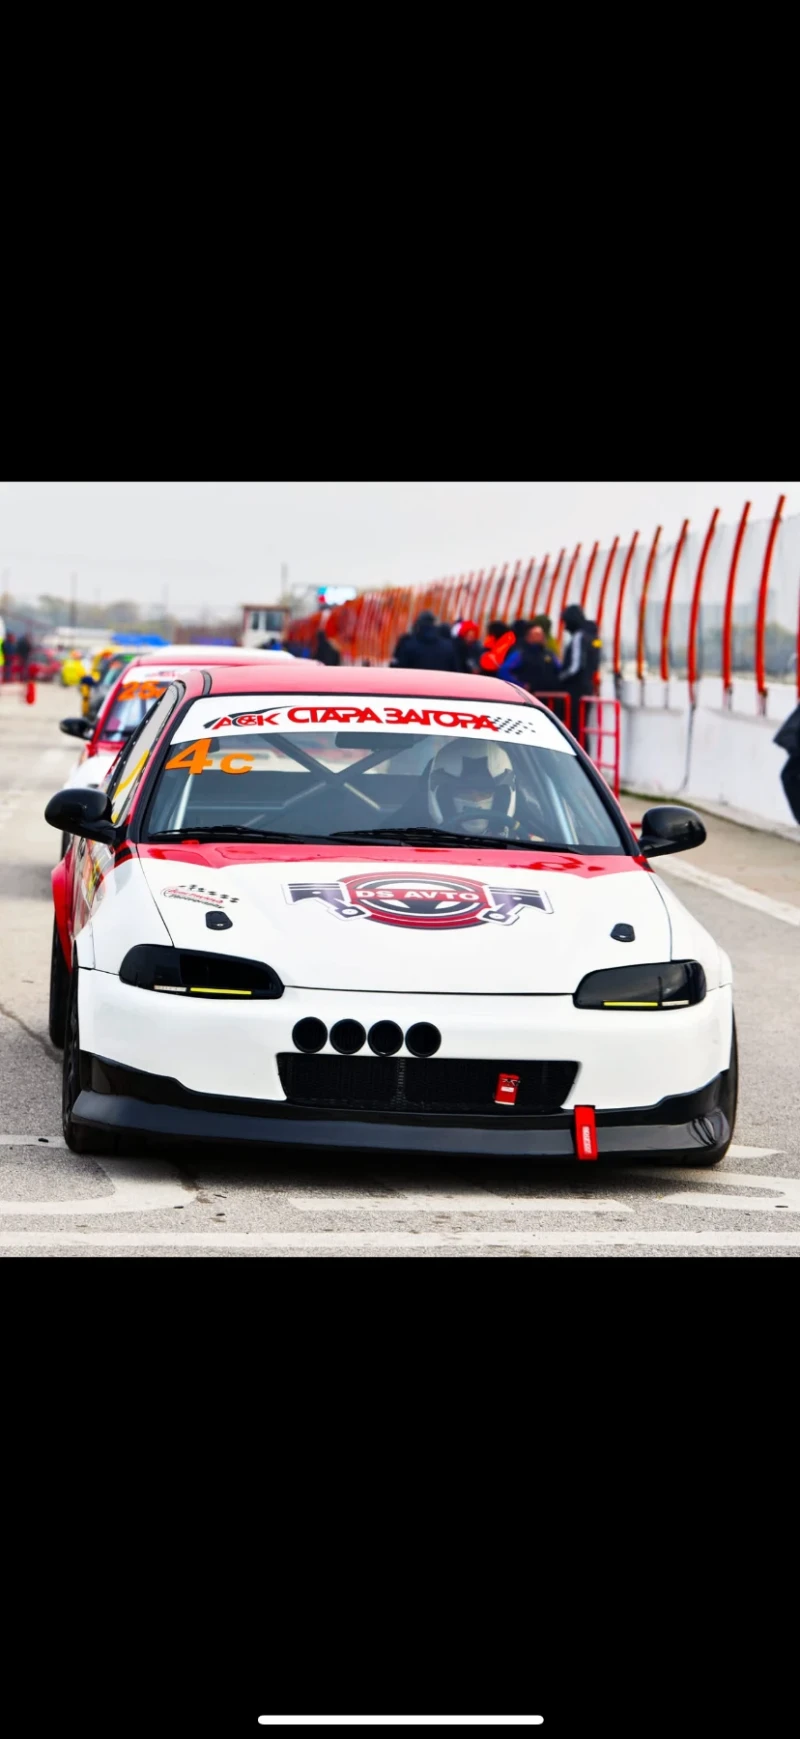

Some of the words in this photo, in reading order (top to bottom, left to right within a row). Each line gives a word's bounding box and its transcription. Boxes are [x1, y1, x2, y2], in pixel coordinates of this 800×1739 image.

[287, 706, 383, 724] СТАРА
[383, 707, 499, 732] ЗАГОРА
[165, 738, 213, 775] 4
[355, 890, 394, 899] DS
[404, 890, 480, 901] AVTO
